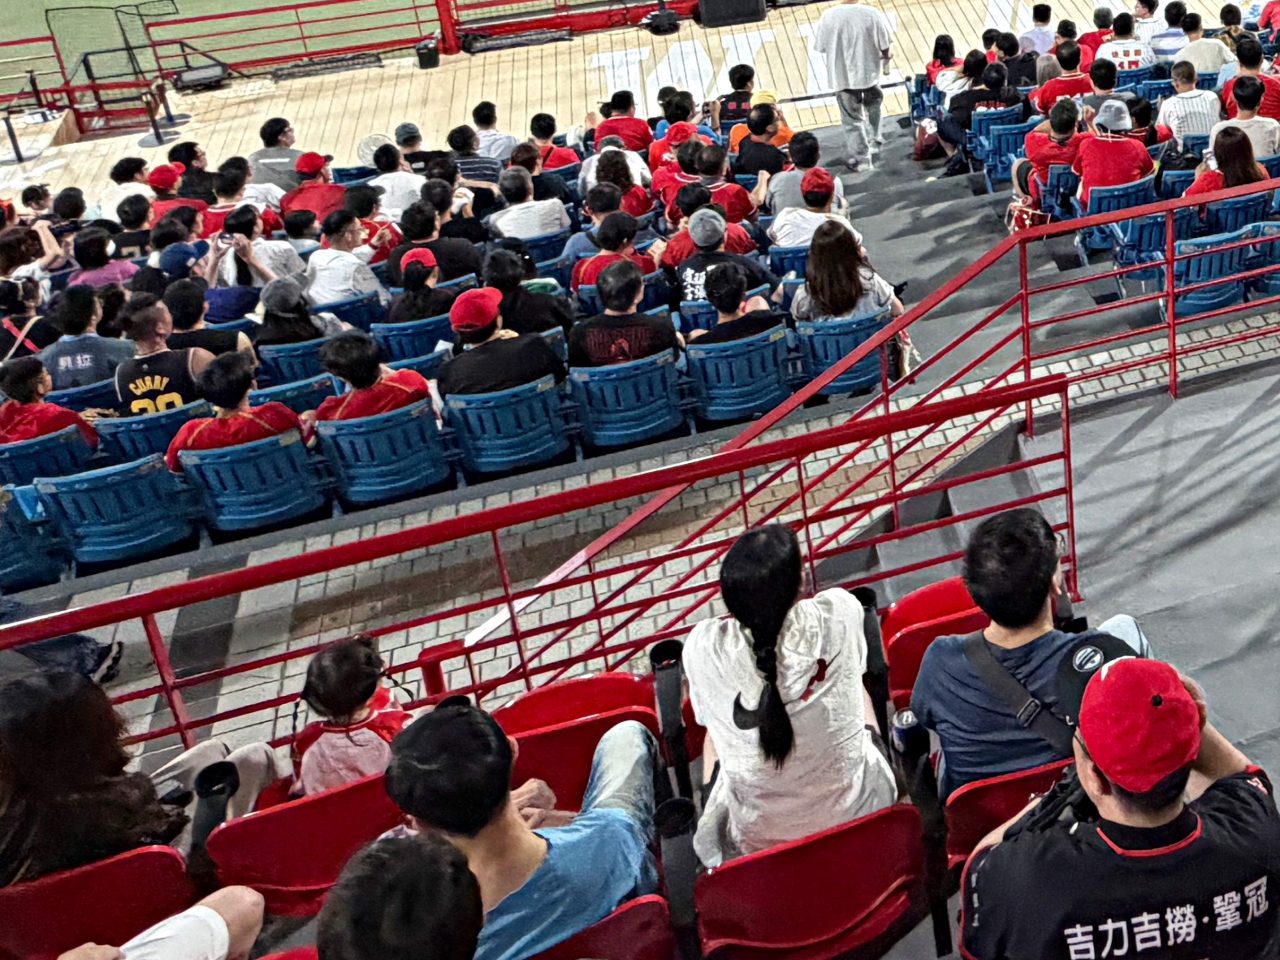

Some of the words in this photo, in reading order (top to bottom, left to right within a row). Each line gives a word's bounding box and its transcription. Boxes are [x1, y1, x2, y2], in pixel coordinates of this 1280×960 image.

[128, 375, 170, 396] CURRY
[1064, 876, 1268, 960] 吉力吉撈·鞏冠
